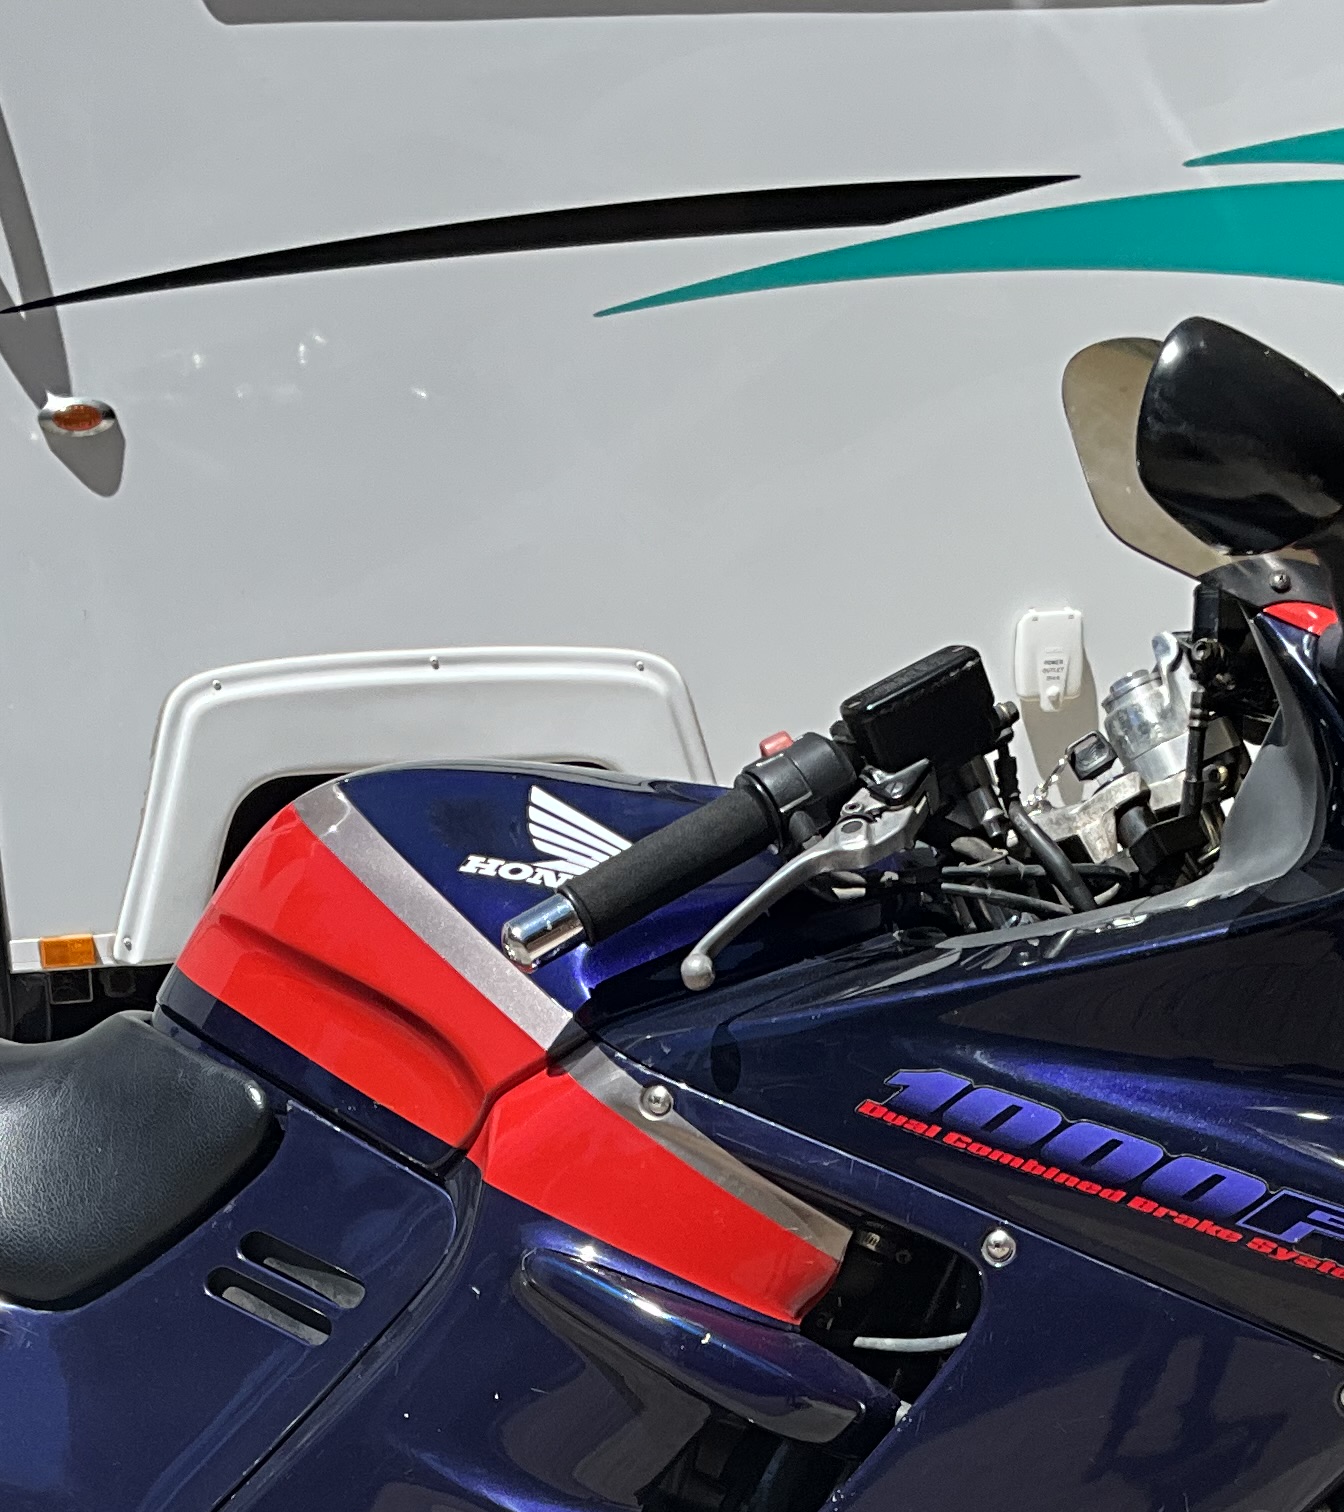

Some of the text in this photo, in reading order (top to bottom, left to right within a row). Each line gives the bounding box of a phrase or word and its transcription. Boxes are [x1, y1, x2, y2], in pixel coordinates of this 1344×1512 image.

[458, 854, 574, 889] HON
[857, 1100, 943, 1138] Dual
[942, 1131, 1127, 1203] Combined
[1126, 1195, 1243, 1243] Brake
